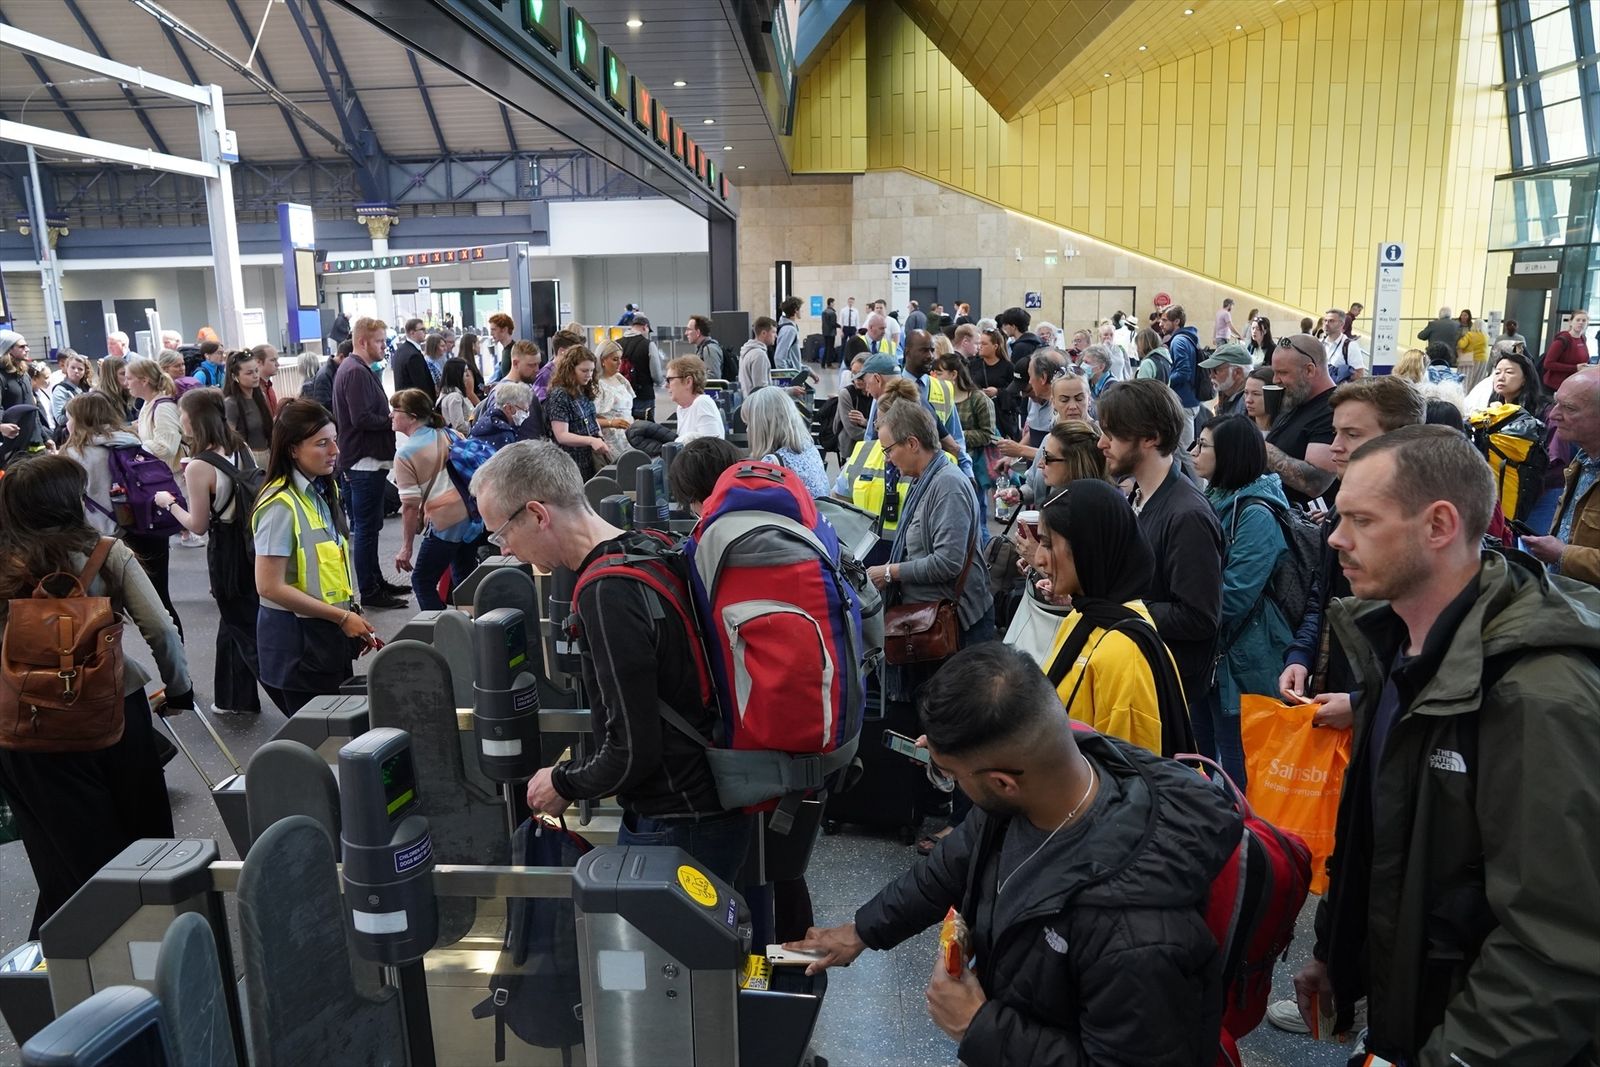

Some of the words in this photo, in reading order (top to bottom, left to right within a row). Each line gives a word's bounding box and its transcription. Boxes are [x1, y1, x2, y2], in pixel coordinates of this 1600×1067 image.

[1436, 748, 1452, 757] THE
[1430, 754, 1452, 764] ORTH
[1430, 762, 1451, 771] FACE
[399, 847, 420, 861] CHILDREN
[400, 858, 413, 867] DOGS
